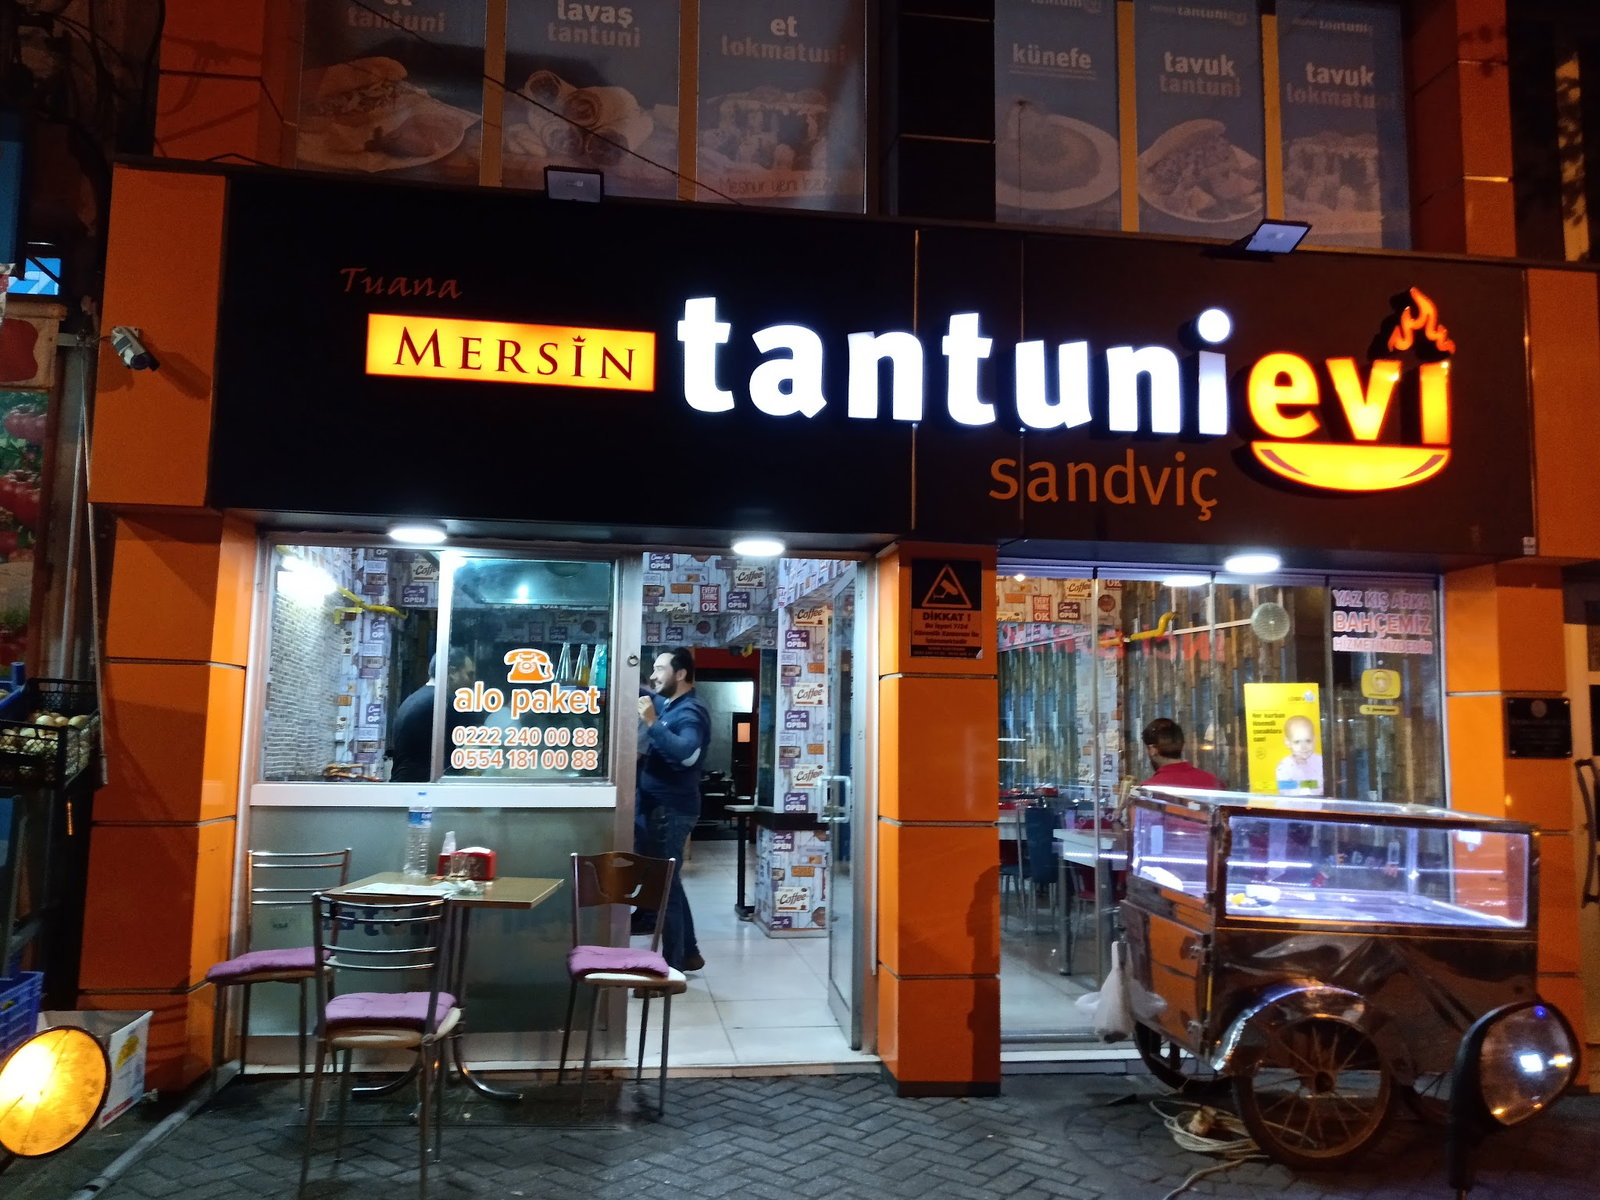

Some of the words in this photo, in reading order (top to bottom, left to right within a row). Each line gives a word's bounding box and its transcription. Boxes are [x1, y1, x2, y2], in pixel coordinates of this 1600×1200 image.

[547, 22, 641, 48] tantuni
[770, 15, 799, 37] et
[1012, 43, 1092, 69] künefe
[1164, 51, 1236, 77] tavuk
[1159, 74, 1241, 97] tantuni
[1306, 62, 1375, 87] tavuk
[340, 265, 464, 300] Tuana
[677, 296, 1228, 436] tantuni
[1247, 349, 1452, 447] evi
[988, 448, 1218, 521] sandviç
[701, 602, 719, 612] OK
[1332, 589, 1363, 608] YAZ
[922, 611, 965, 621] DİKKAT
[1034, 612, 1049, 621] OK
[453, 681, 504, 713] alo
[511, 682, 601, 720] paket
[797, 688, 823, 700] Coffee
[451, 725, 503, 747] 0222
[504, 726, 543, 747] 240
[544, 727, 572, 748] 00
[572, 727, 600, 748] 88
[450, 747, 504, 770] 0554
[505, 748, 539, 770] 181
[541, 748, 570, 771] 00
[570, 749, 599, 771] 88
